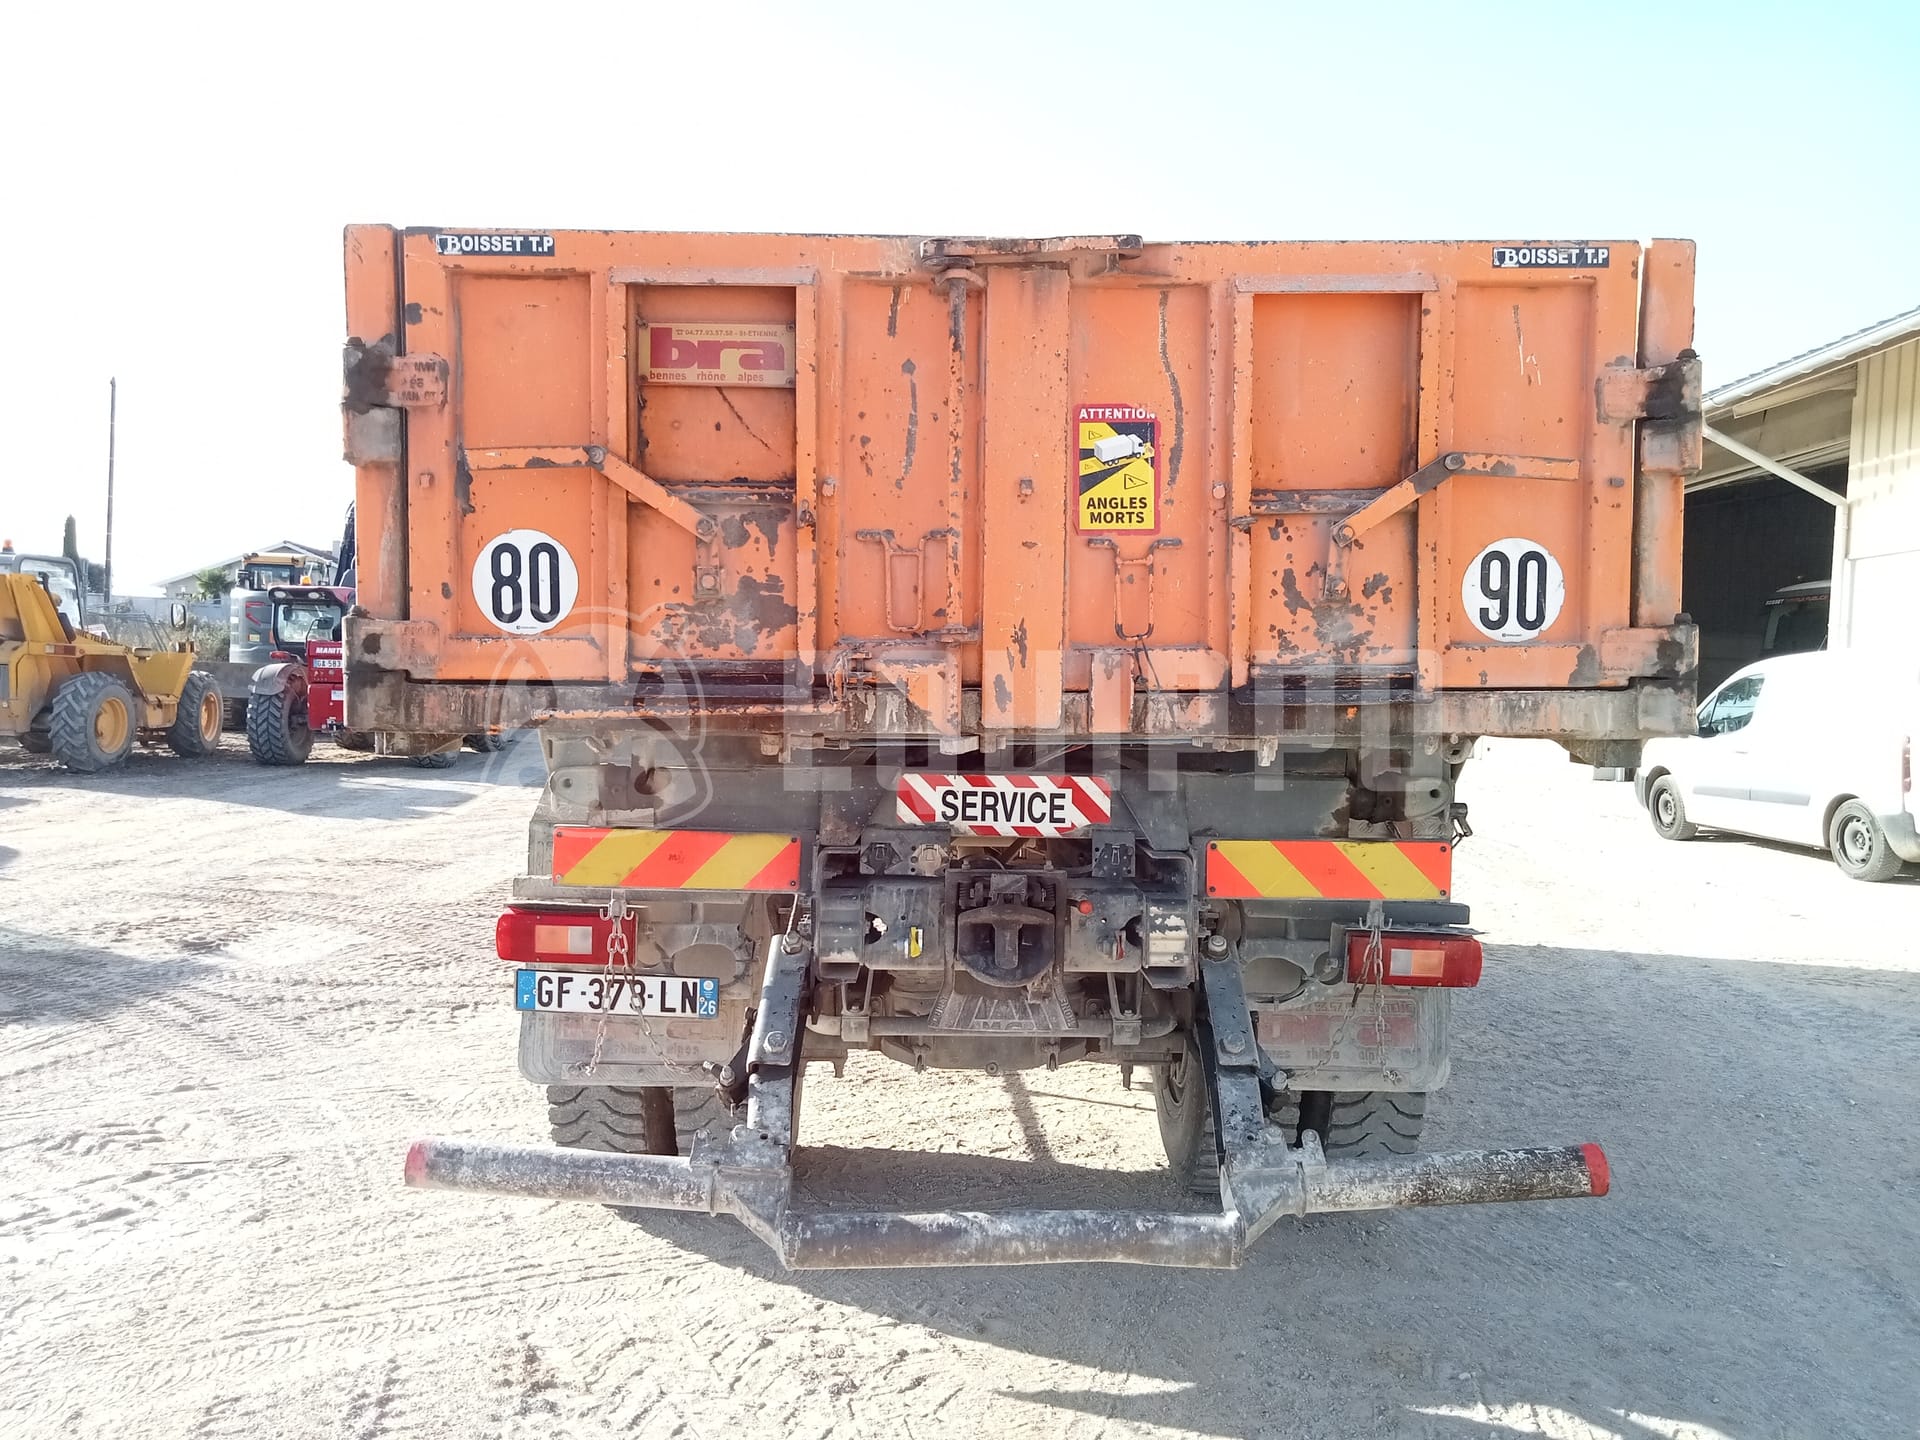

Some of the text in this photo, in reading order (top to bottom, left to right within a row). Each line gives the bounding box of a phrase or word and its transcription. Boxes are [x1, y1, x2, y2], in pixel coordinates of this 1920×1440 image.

[446, 235, 554, 253] BOISSET T.P
[1504, 248, 1609, 265] BOISSET T.P
[650, 327, 785, 370] bra
[650, 370, 764, 384] bennes rhône alpes
[1086, 497, 1147, 510] ANGLES
[1089, 511, 1145, 524] MORTS
[490, 542, 560, 624] 80
[1479, 550, 1547, 631] 90
[941, 789, 1066, 824] SERVICE
[523, 994, 530, 1004] F
[700, 1000, 716, 1015] 26
